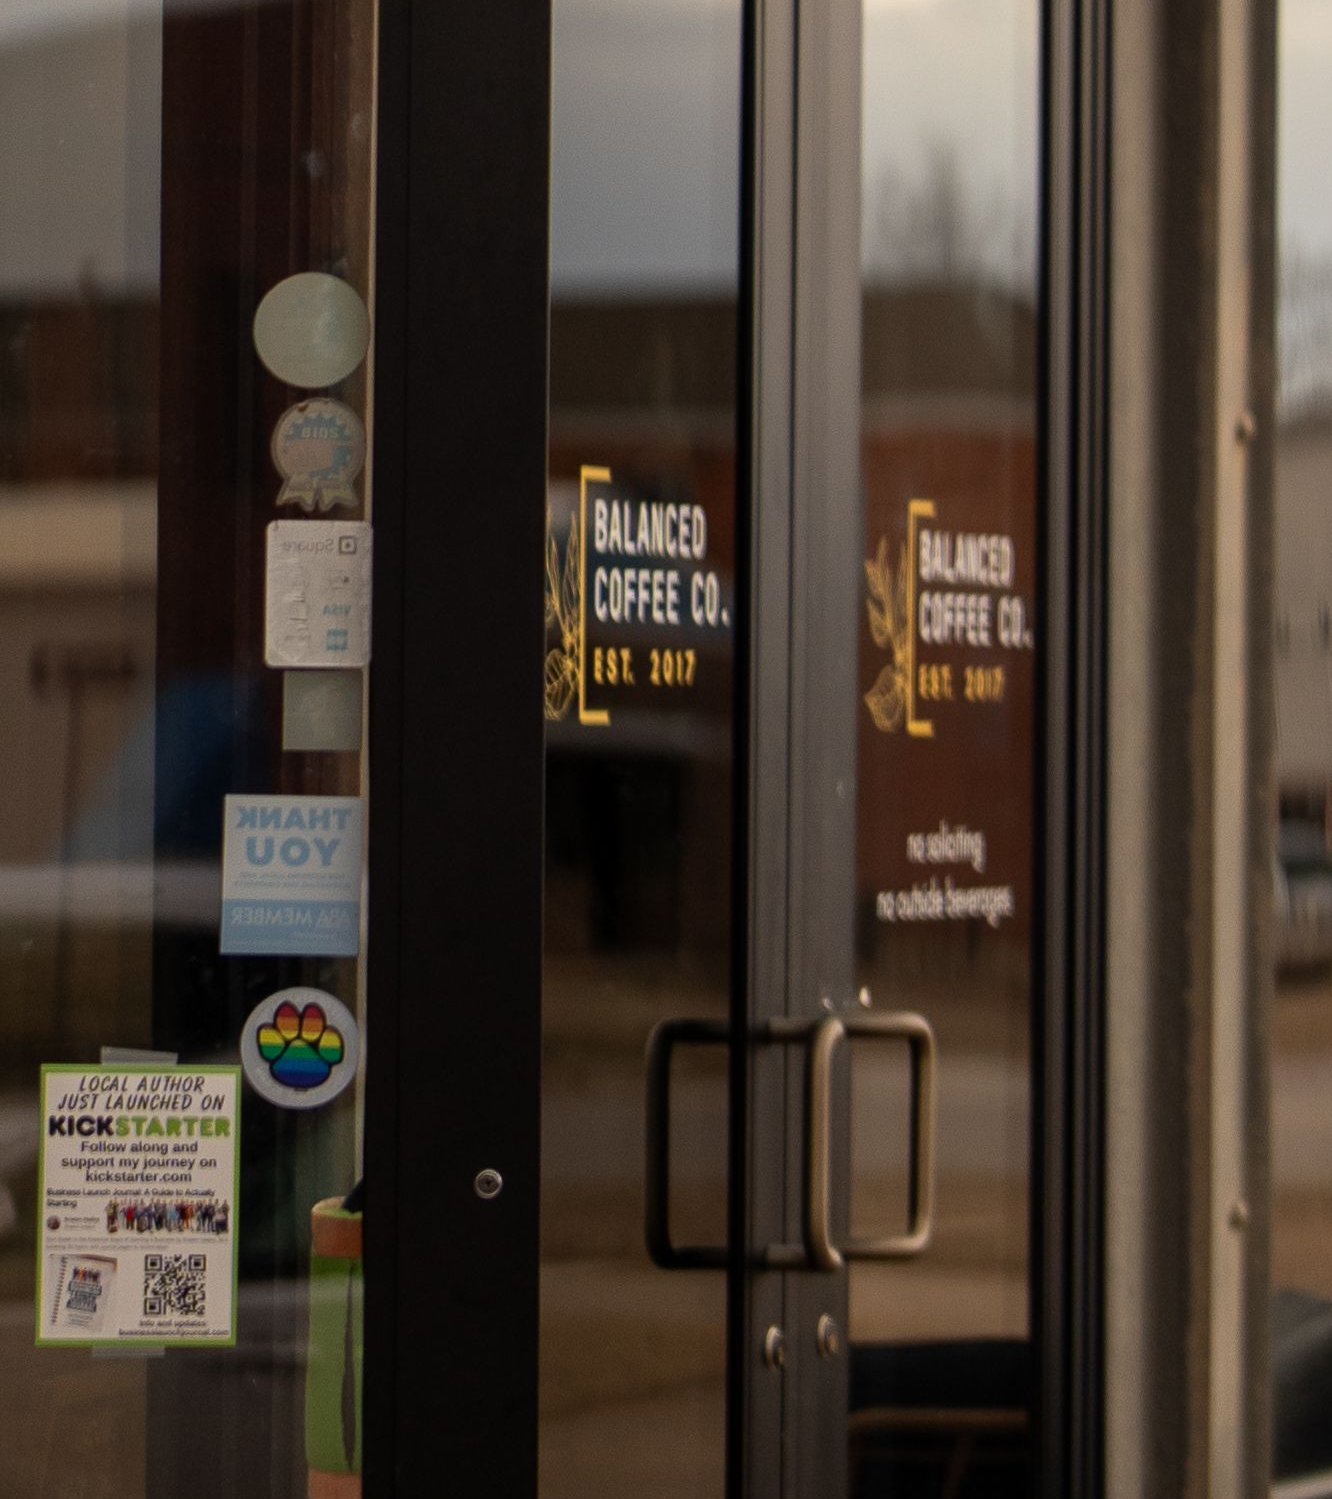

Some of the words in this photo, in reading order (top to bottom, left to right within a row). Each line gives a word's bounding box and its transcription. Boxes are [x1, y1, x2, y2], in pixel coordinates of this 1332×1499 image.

[594, 499, 707, 559] BALANCED
[919, 531, 1014, 586] BALANCED
[594, 568, 681, 625] COFFEE
[691, 573, 731, 628] CO.
[918, 594, 991, 648] COFFEE
[997, 599, 1034, 650] CO.
[594, 649, 635, 686] EST.
[649, 649, 697, 686] 2017
[918, 664, 953, 701] EST.
[964, 665, 1005, 702] 2017
[79, 1075, 128, 1092] LOCAL
[137, 1075, 205, 1092] AUTHOR
[58, 1093, 99, 1110] JUST
[105, 1093, 193, 1111] LAUNCHED
[201, 1094, 226, 1110] ON
[48, 1114, 231, 1137] KICKSTARTER
[61, 1156, 114, 1170] support
[119, 1158, 139, 1170] my
[143, 1156, 195, 1171] journey
[199, 1158, 217, 1167] on
[80, 1141, 126, 1152] Follow
[130, 1141, 168, 1156] along
[173, 1141, 198, 1152] and
[85, 1171, 192, 1183] kickstarter.com
